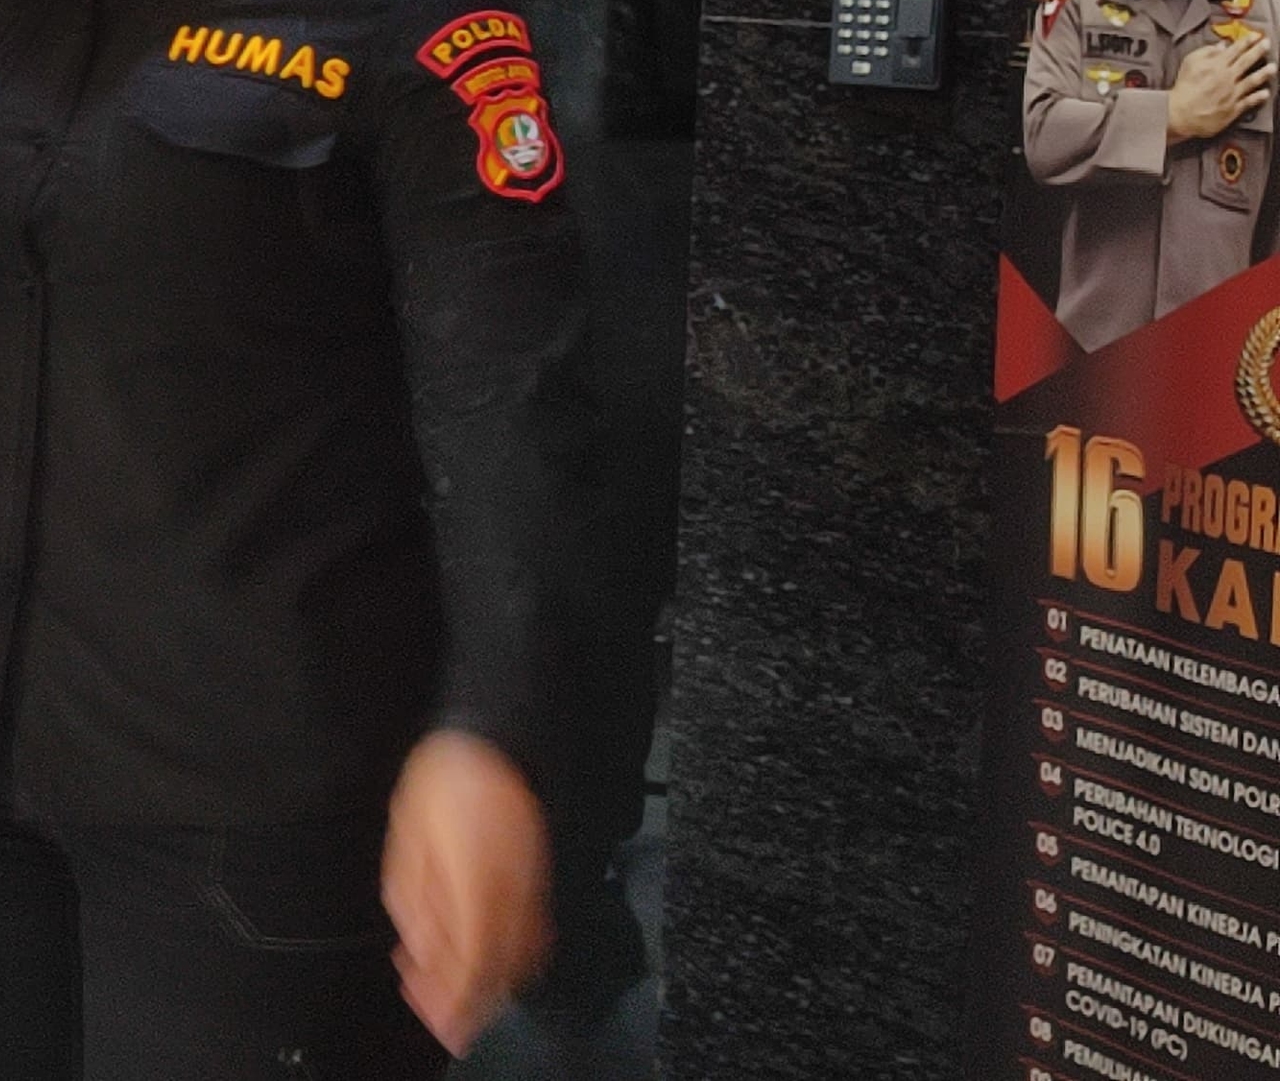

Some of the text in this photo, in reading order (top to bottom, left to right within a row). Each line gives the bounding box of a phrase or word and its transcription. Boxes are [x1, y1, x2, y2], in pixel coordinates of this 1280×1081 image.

[167, 25, 352, 101] HUMAS
[432, 18, 522, 65] POLDA
[1044, 424, 1147, 592] 16
[1160, 461, 1280, 555] PROGR
[1046, 607, 1068, 632] 01
[1079, 625, 1172, 673] PENATAAN
[1044, 657, 1068, 684] 02
[1077, 676, 1177, 728] PERUBAHAN
[1179, 710, 1239, 749] SISTEM
[1041, 707, 1064, 732] 03
[1076, 727, 1186, 785] MENJADIKAN
[1189, 766, 1230, 800] SDM
[1040, 761, 1280, 870] 04 PERUBAHAN TEKNOLOGI
[1072, 805, 1161, 856] POLICE 4.0
[1036, 831, 1059, 857] 05
[1070, 856, 1185, 920] PEMANTAPAN
[1187, 902, 1263, 949] KINERJA
[1032, 942, 1056, 968] 07
[1066, 962, 1180, 1029] PEMANTAPAN
[1035, 888, 1058, 915] 06
[1068, 910, 1188, 978] PENINGKATAN
[1189, 959, 1266, 1009] KINERJA
[1029, 1016, 1053, 1043] 08
[1065, 989, 1149, 1041] COVID-19
